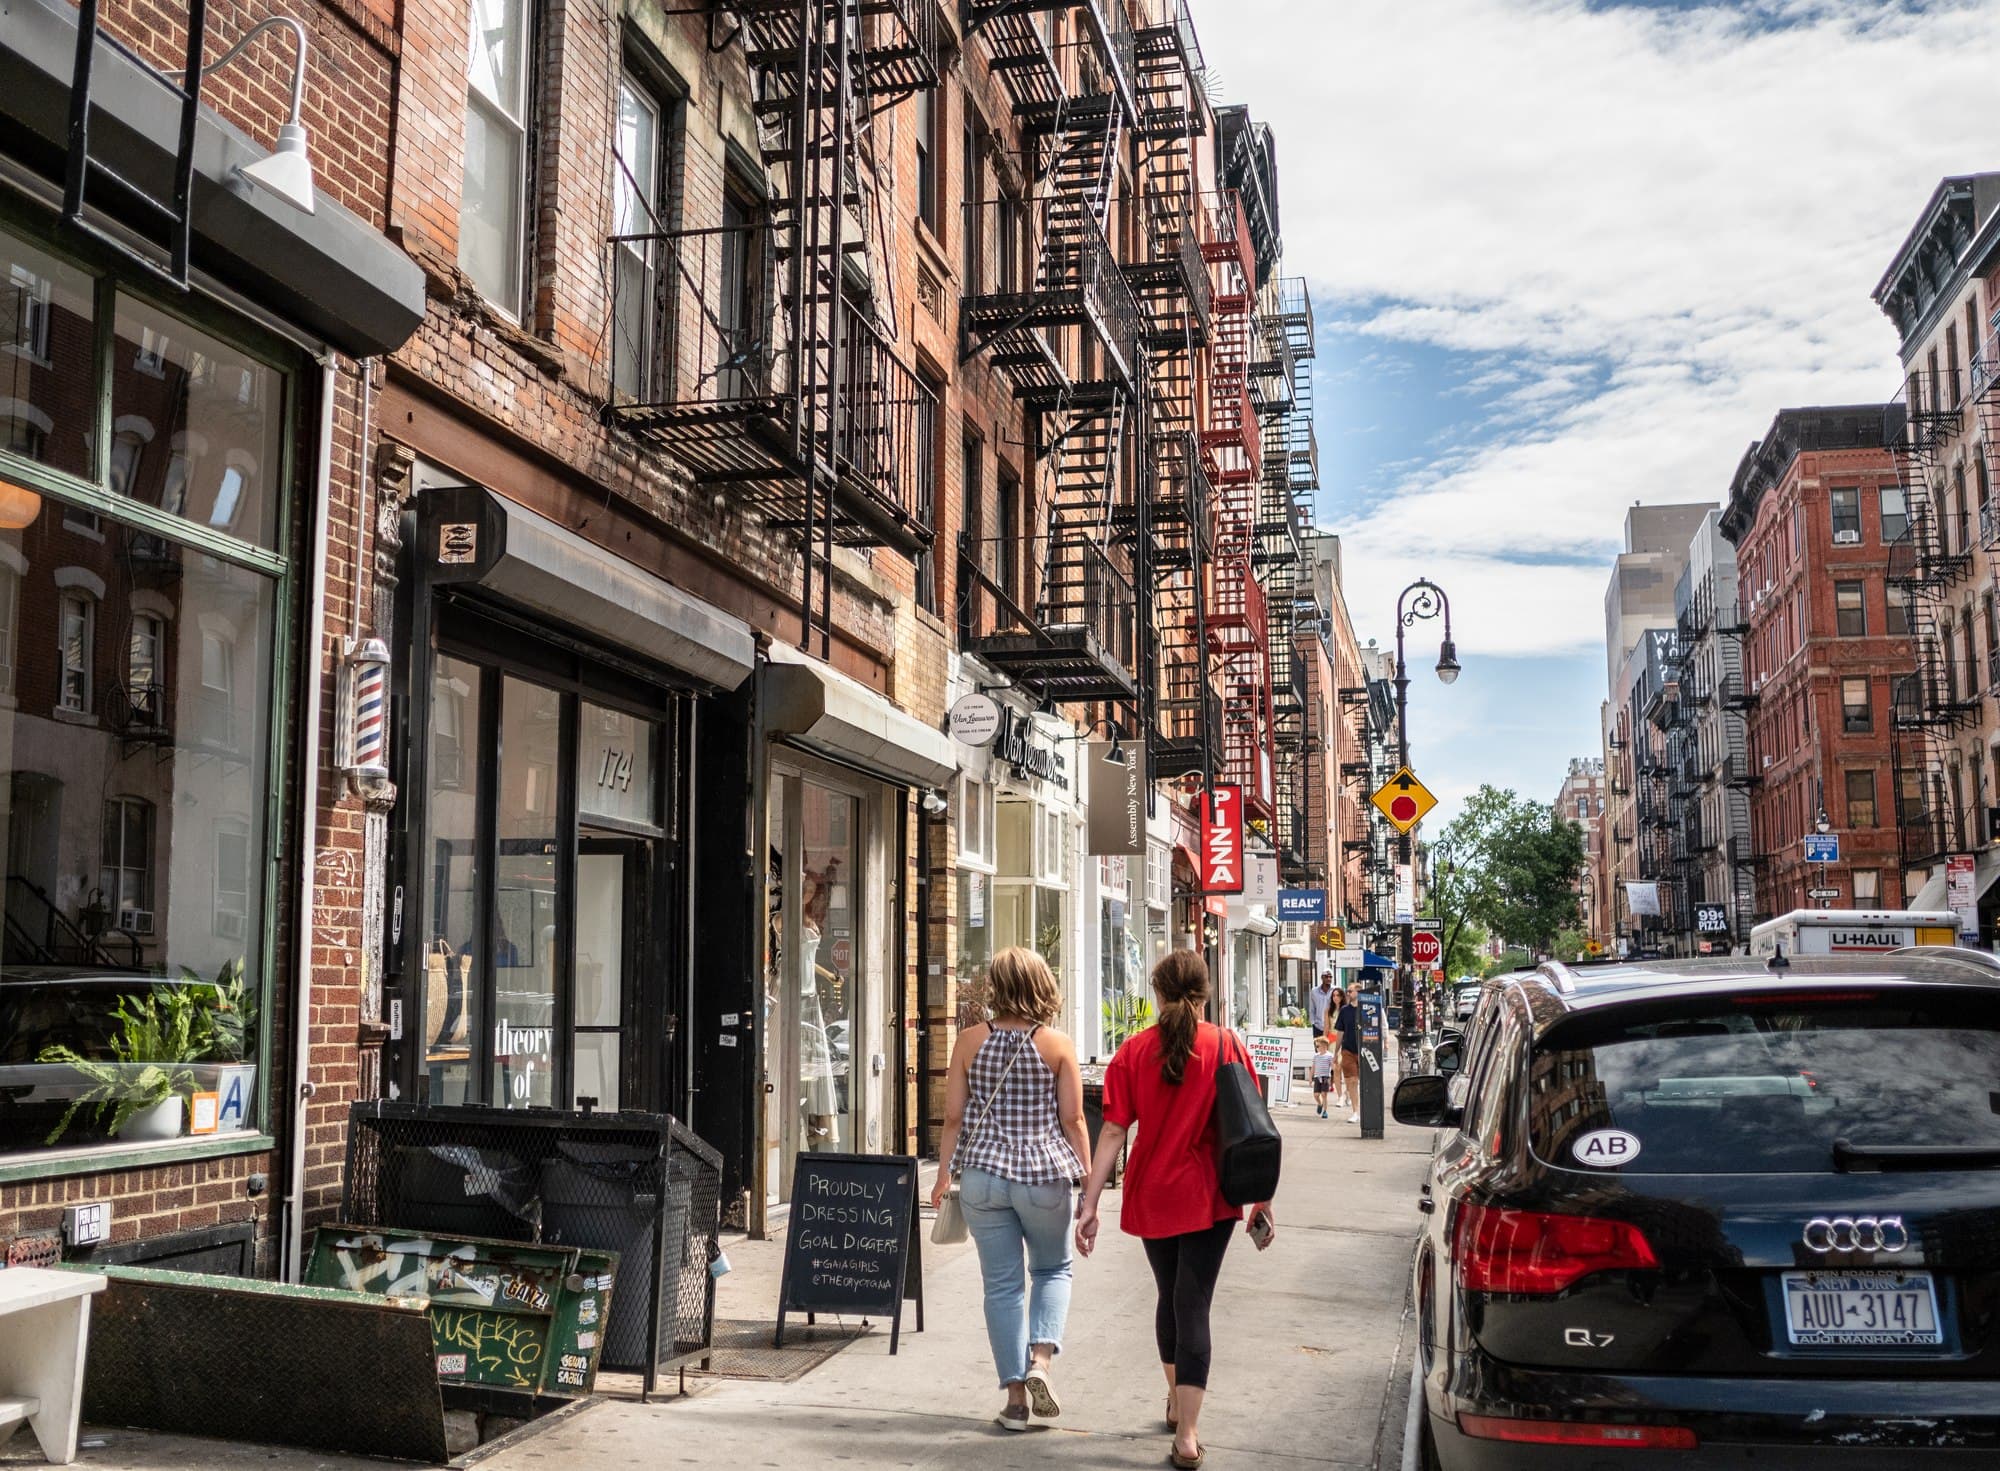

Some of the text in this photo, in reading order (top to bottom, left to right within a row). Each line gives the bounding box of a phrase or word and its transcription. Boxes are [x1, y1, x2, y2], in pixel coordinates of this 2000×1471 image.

[953, 713, 995, 724] Van Leeuwen
[1003, 703, 1022, 764] Van
[598, 746, 634, 793] 174
[1127, 748, 1140, 847] Assembly New York
[1209, 790, 1235, 884] PIZZA
[1698, 910, 1725, 922] 99¢
[1699, 921, 1727, 931] PIZZA
[1832, 933, 1901, 945] U-HAUL
[494, 1018, 553, 1062] theory
[513, 1061, 535, 1099] of
[219, 1075, 242, 1121] A
[1585, 1137, 1628, 1157] AB
[809, 1174, 886, 1204] PROUDLY
[802, 1203, 893, 1228] DRESSING
[799, 1229, 899, 1254] GOAL DIGGERS
[507, 1278, 550, 1310] GANZ!
[1819, 1279, 1896, 1290] NEW YORK
[1802, 1293, 1918, 1329] AUU 3147
[1564, 1328, 1615, 1347] Q7
[1801, 1335, 1936, 1344] AUDI MANHATTAN
